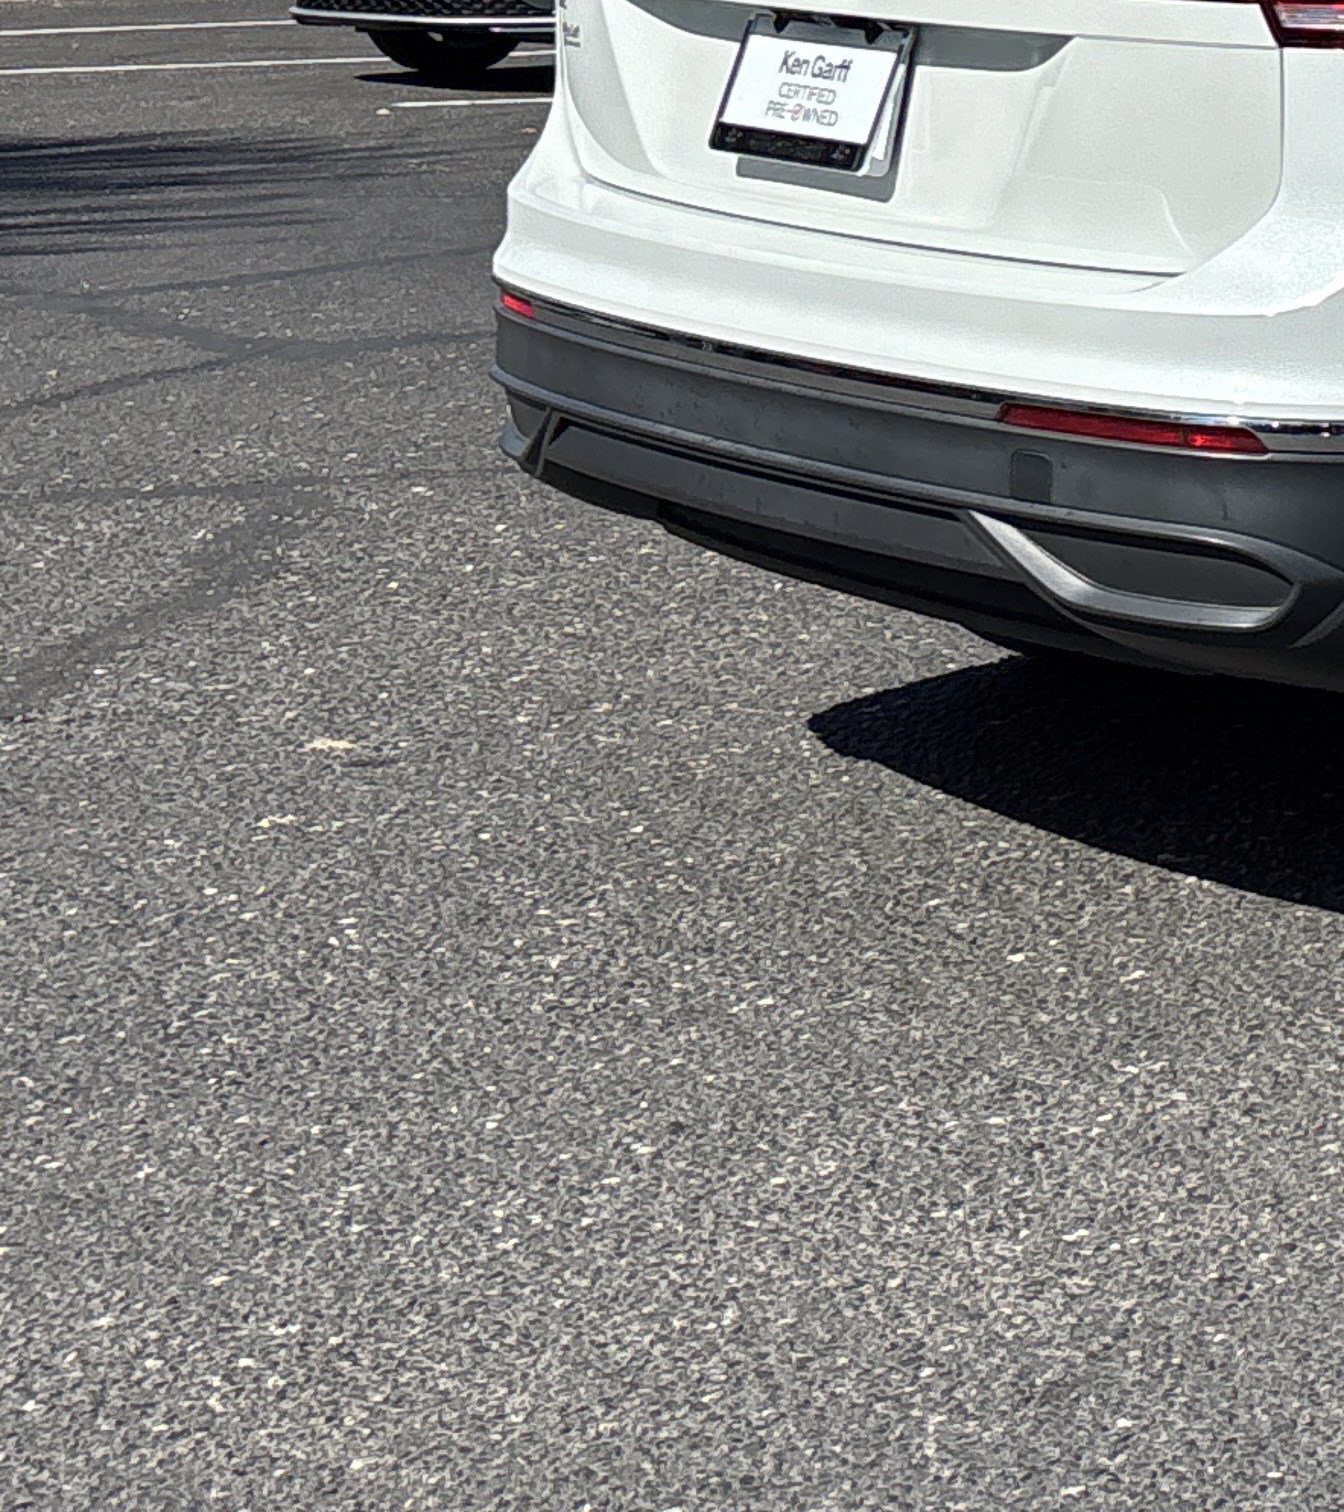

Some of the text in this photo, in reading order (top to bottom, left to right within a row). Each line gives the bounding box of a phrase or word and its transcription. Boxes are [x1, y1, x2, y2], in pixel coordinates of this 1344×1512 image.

[778, 49, 853, 83] Ken Garff
[778, 81, 837, 105] CERTIFIED
[765, 99, 839, 127] PRE-OWNED
